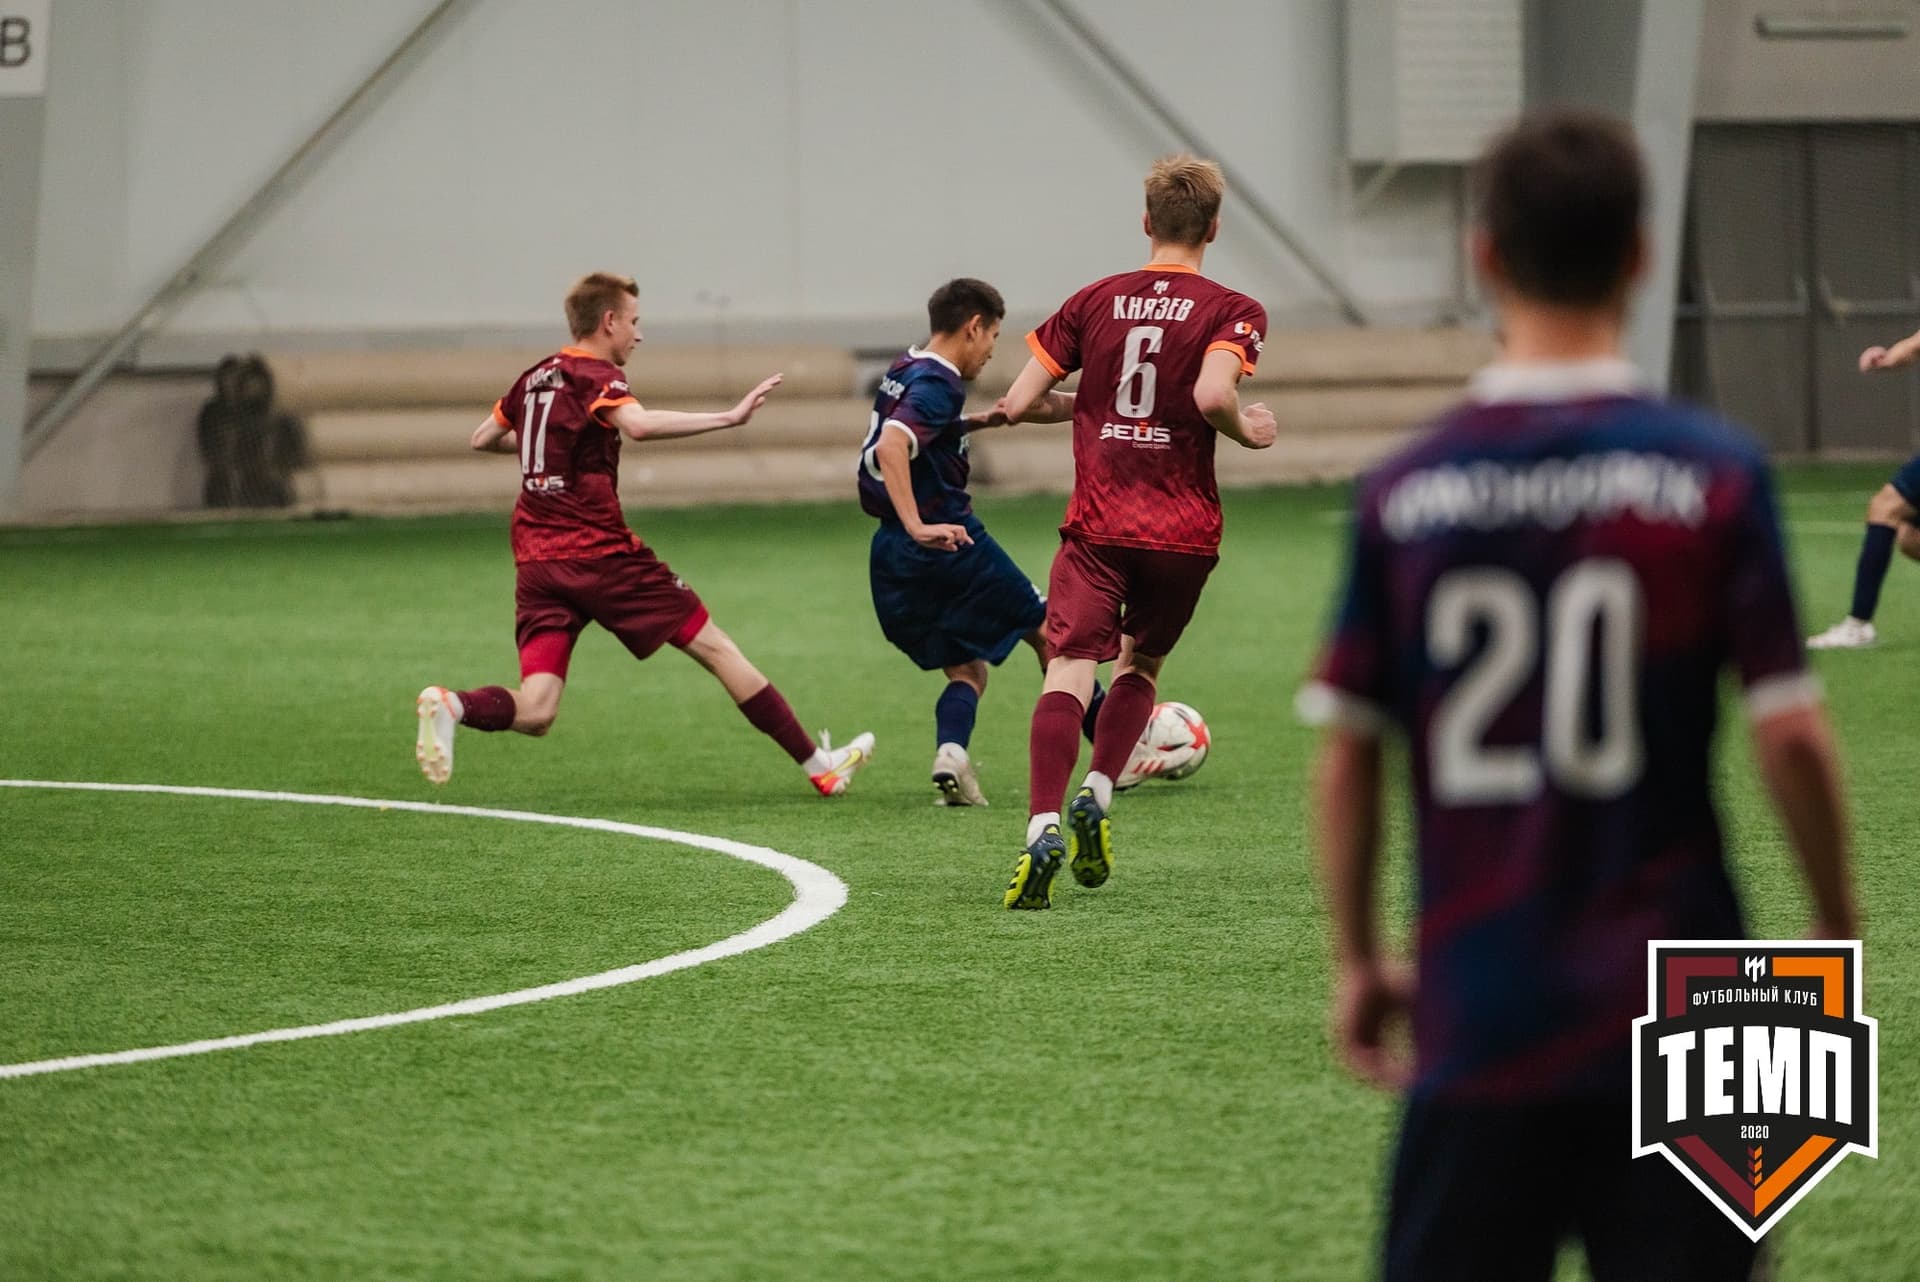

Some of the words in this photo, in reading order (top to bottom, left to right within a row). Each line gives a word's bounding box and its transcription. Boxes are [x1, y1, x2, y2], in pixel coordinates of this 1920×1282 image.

[1113, 295, 1195, 321] КНЯЗЕВ
[1115, 325, 1164, 419] 6
[522, 391, 555, 474] 17
[1426, 561, 1646, 806] 20
